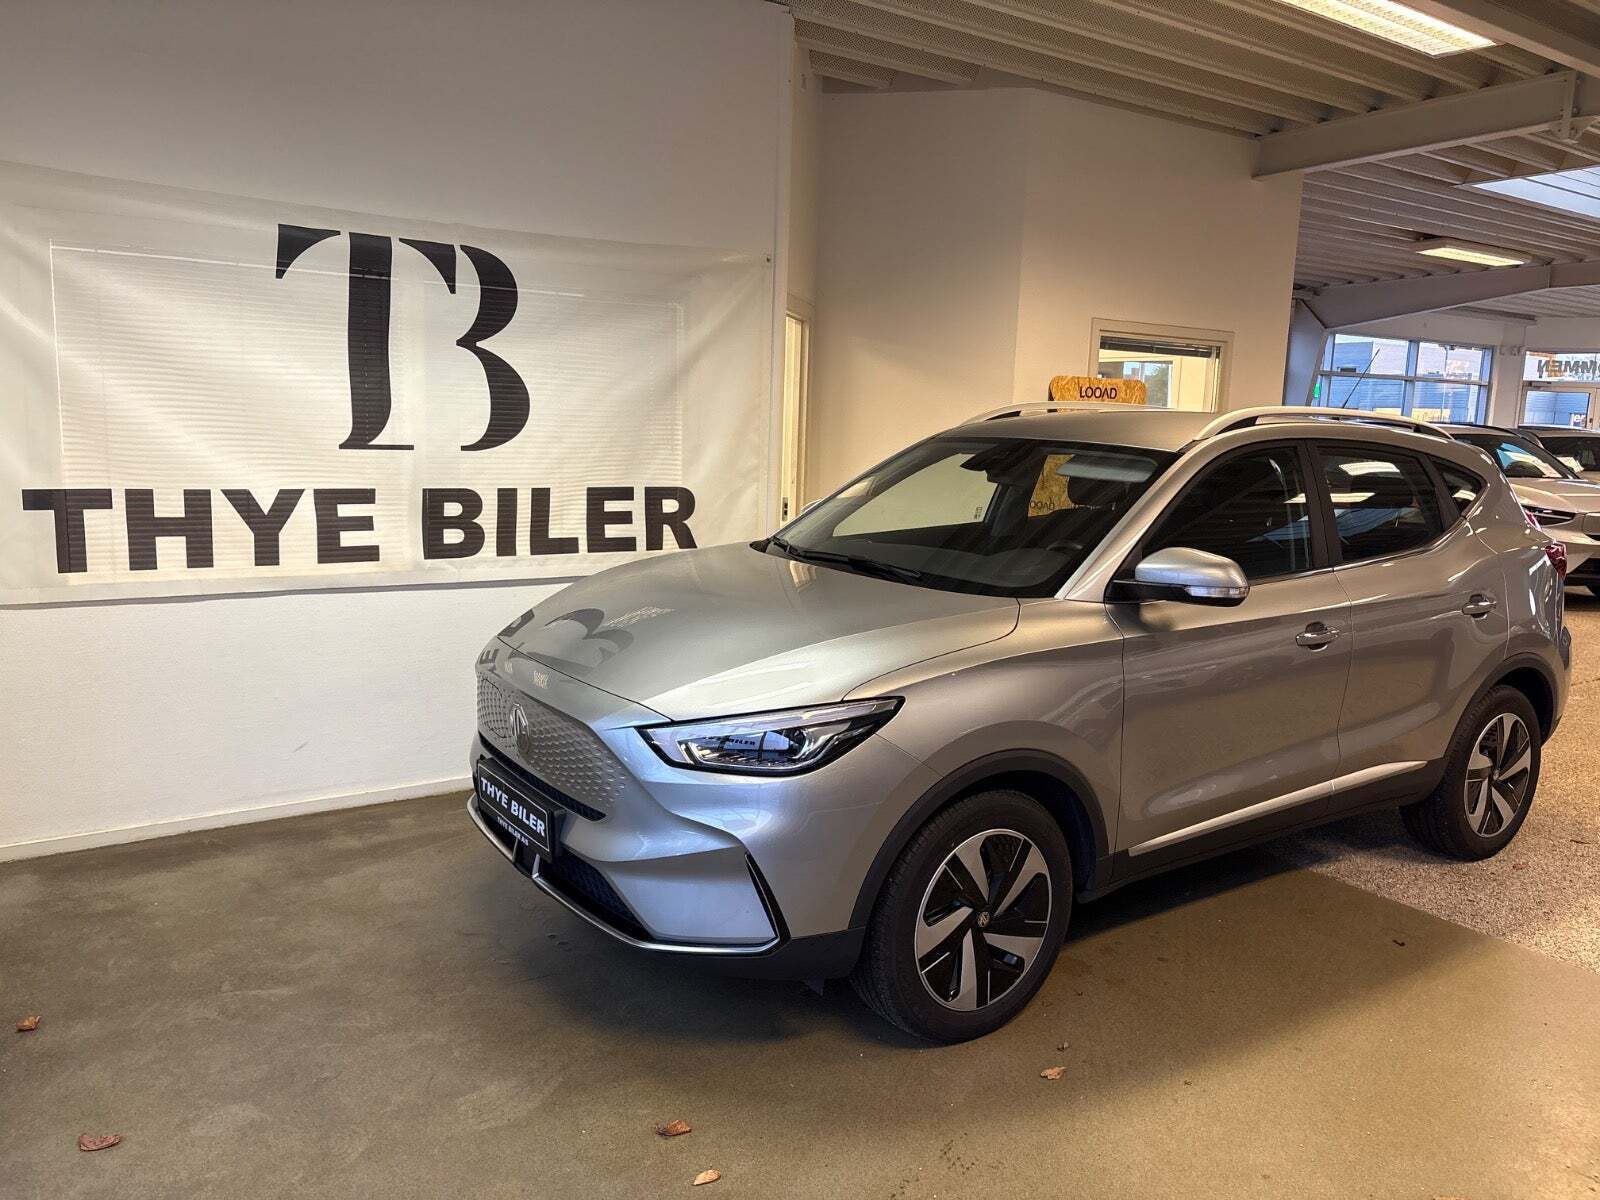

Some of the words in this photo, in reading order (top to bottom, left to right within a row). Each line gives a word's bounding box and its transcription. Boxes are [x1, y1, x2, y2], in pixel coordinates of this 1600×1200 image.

[1079, 386, 1118, 400] LOOAD
[21, 488, 381, 574] THYE
[422, 486, 698, 560] BILER
[480, 777, 509, 809] THYE
[510, 800, 546, 837] BILER
